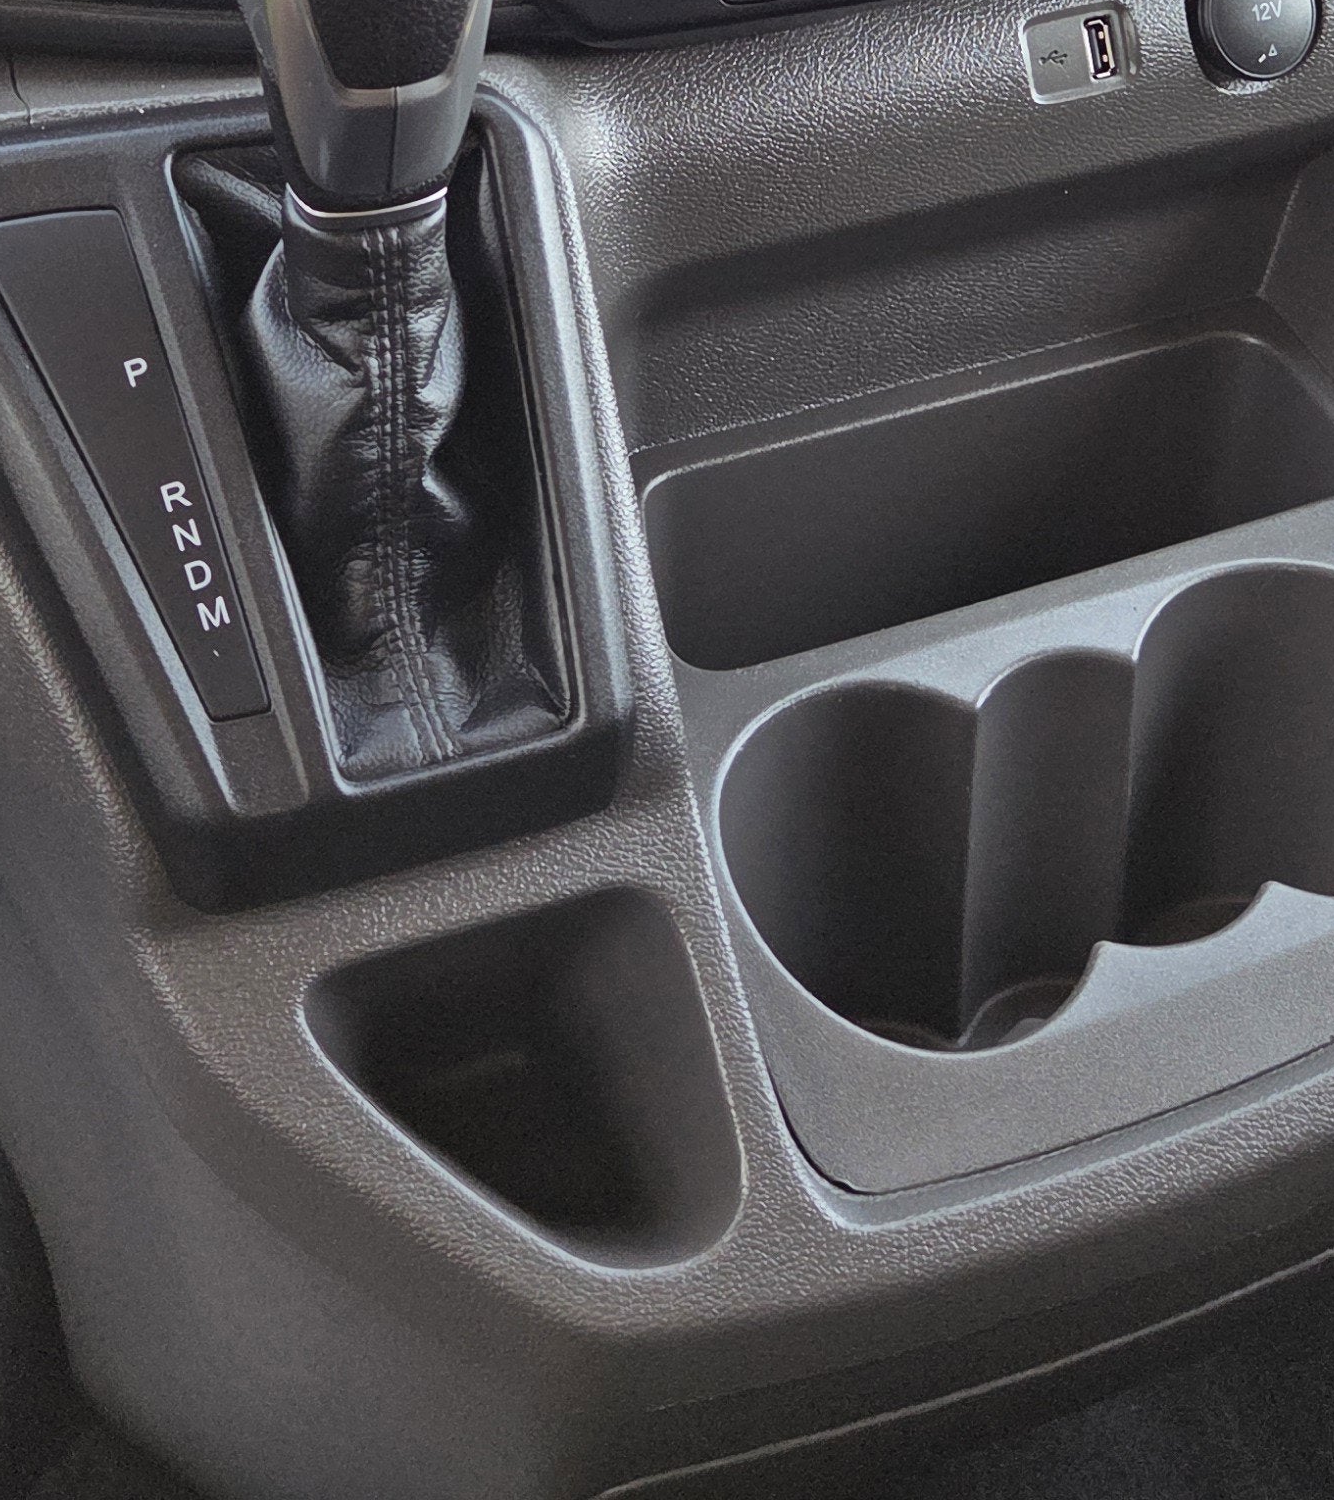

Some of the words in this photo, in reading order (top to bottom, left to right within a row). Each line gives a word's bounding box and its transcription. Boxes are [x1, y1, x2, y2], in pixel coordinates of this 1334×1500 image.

[1252, 0, 1283, 23] 12V
[123, 357, 148, 388] P
[160, 480, 193, 513] R
[172, 518, 202, 552] N
[184, 559, 212, 591] D
[196, 595, 230, 631] M
